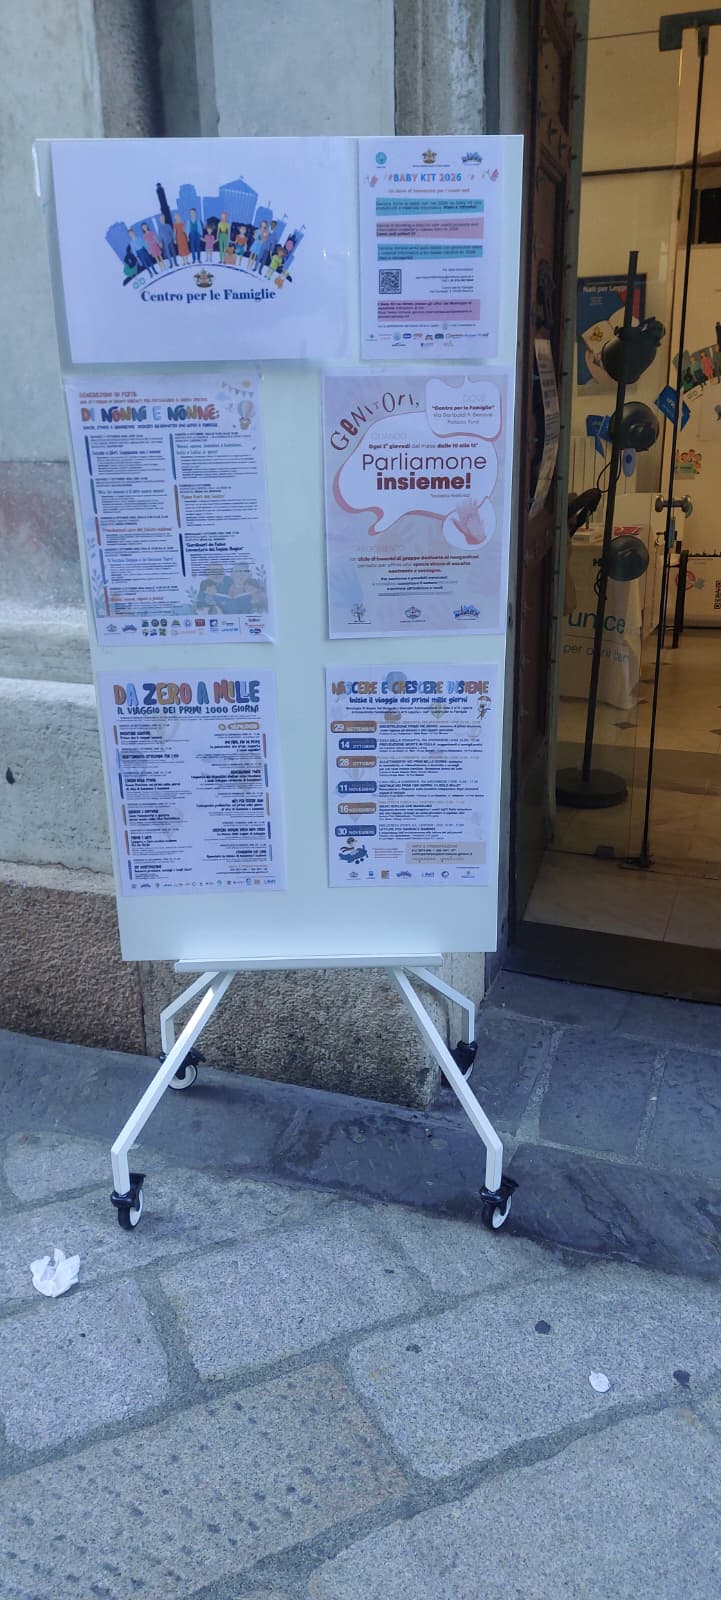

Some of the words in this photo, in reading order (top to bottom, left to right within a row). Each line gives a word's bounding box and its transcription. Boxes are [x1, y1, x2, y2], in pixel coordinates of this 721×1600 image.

[393, 173, 418, 182] BABY
[420, 173, 436, 182] KIT
[439, 173, 462, 182] 2026
[141, 291, 183, 302] Centro
[187, 293, 206, 303] per
[210, 290, 220, 300] le
[224, 289, 276, 302] Famiglie
[81, 406, 96, 422] DI
[101, 406, 146, 422] NONNI
[153, 406, 162, 420] E
[362, 453, 487, 471] Parliamone
[377, 472, 471, 490] insieme!
[568, 612, 626, 634] unce
[113, 683, 139, 706] DA
[142, 682, 193, 706] ZERO
[197, 681, 210, 704] A
[213, 680, 260, 704] MILLE
[332, 680, 378, 694] NASCERE
[382, 681, 388, 694] E
[392, 680, 444, 694] CRESCERE
[448, 680, 489, 695] INSIEME
[374, 696, 398, 704] viaggio
[411, 696, 430, 704] primi
[448, 696, 468, 704] giorni
[118, 706, 124, 715] IL
[128, 706, 160, 714] VIAGGIO
[179, 706, 202, 714] PRIMI
[232, 704, 259, 714] GIORNI
[340, 784, 348, 792] 11
[338, 828, 348, 836] 30
